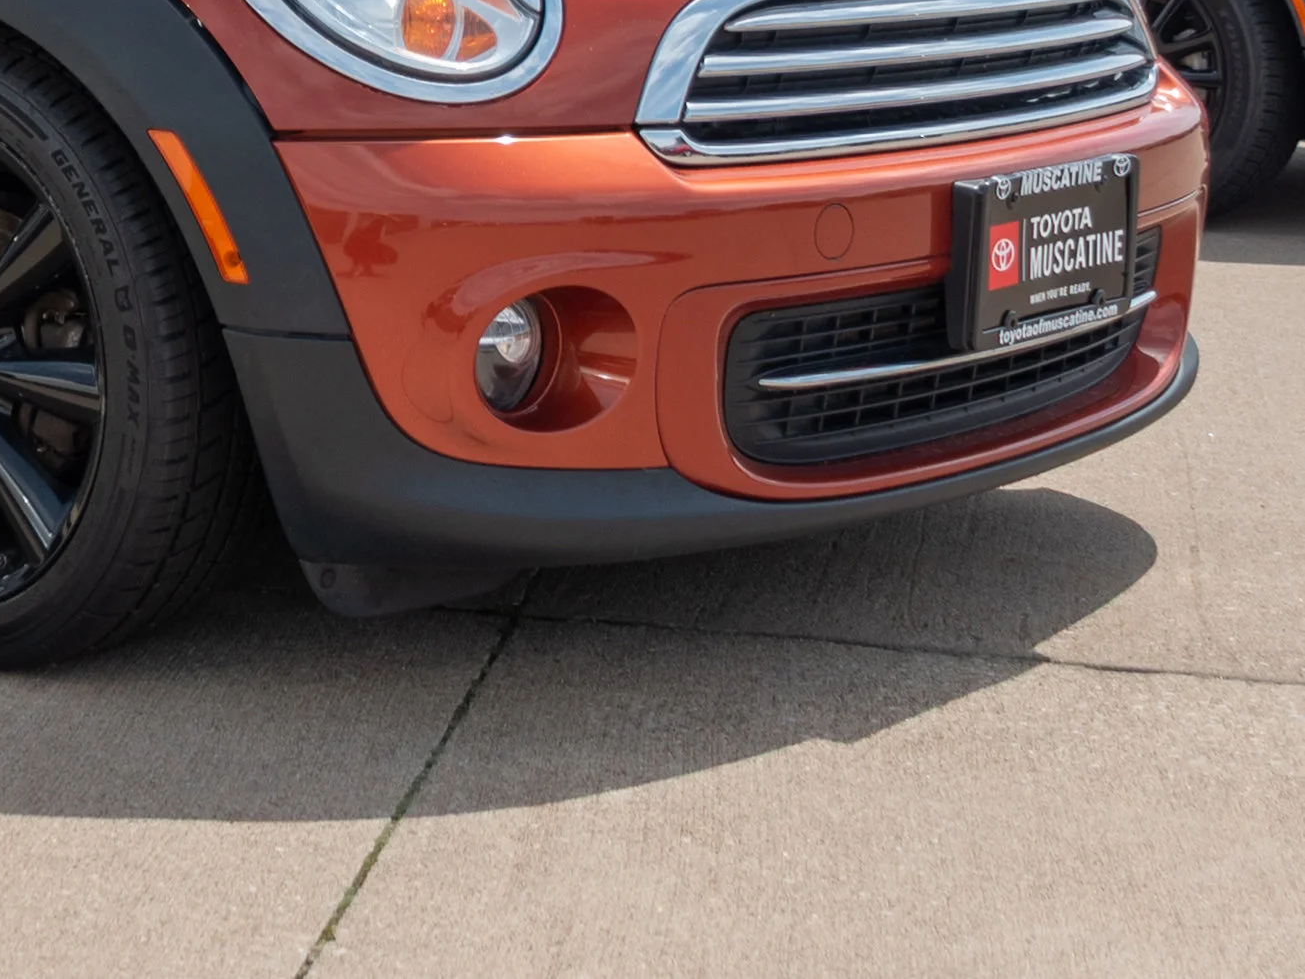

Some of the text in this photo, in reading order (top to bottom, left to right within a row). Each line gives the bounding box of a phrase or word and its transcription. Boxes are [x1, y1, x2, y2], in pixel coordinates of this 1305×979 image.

[1021, 161, 1103, 196] MUSCATINE
[51, 149, 119, 277] GENERAL
[1031, 206, 1092, 239] TOYOTA
[1030, 229, 1124, 280] MUSCATINE
[999, 304, 1118, 345] toyotaofmuscatine.com
